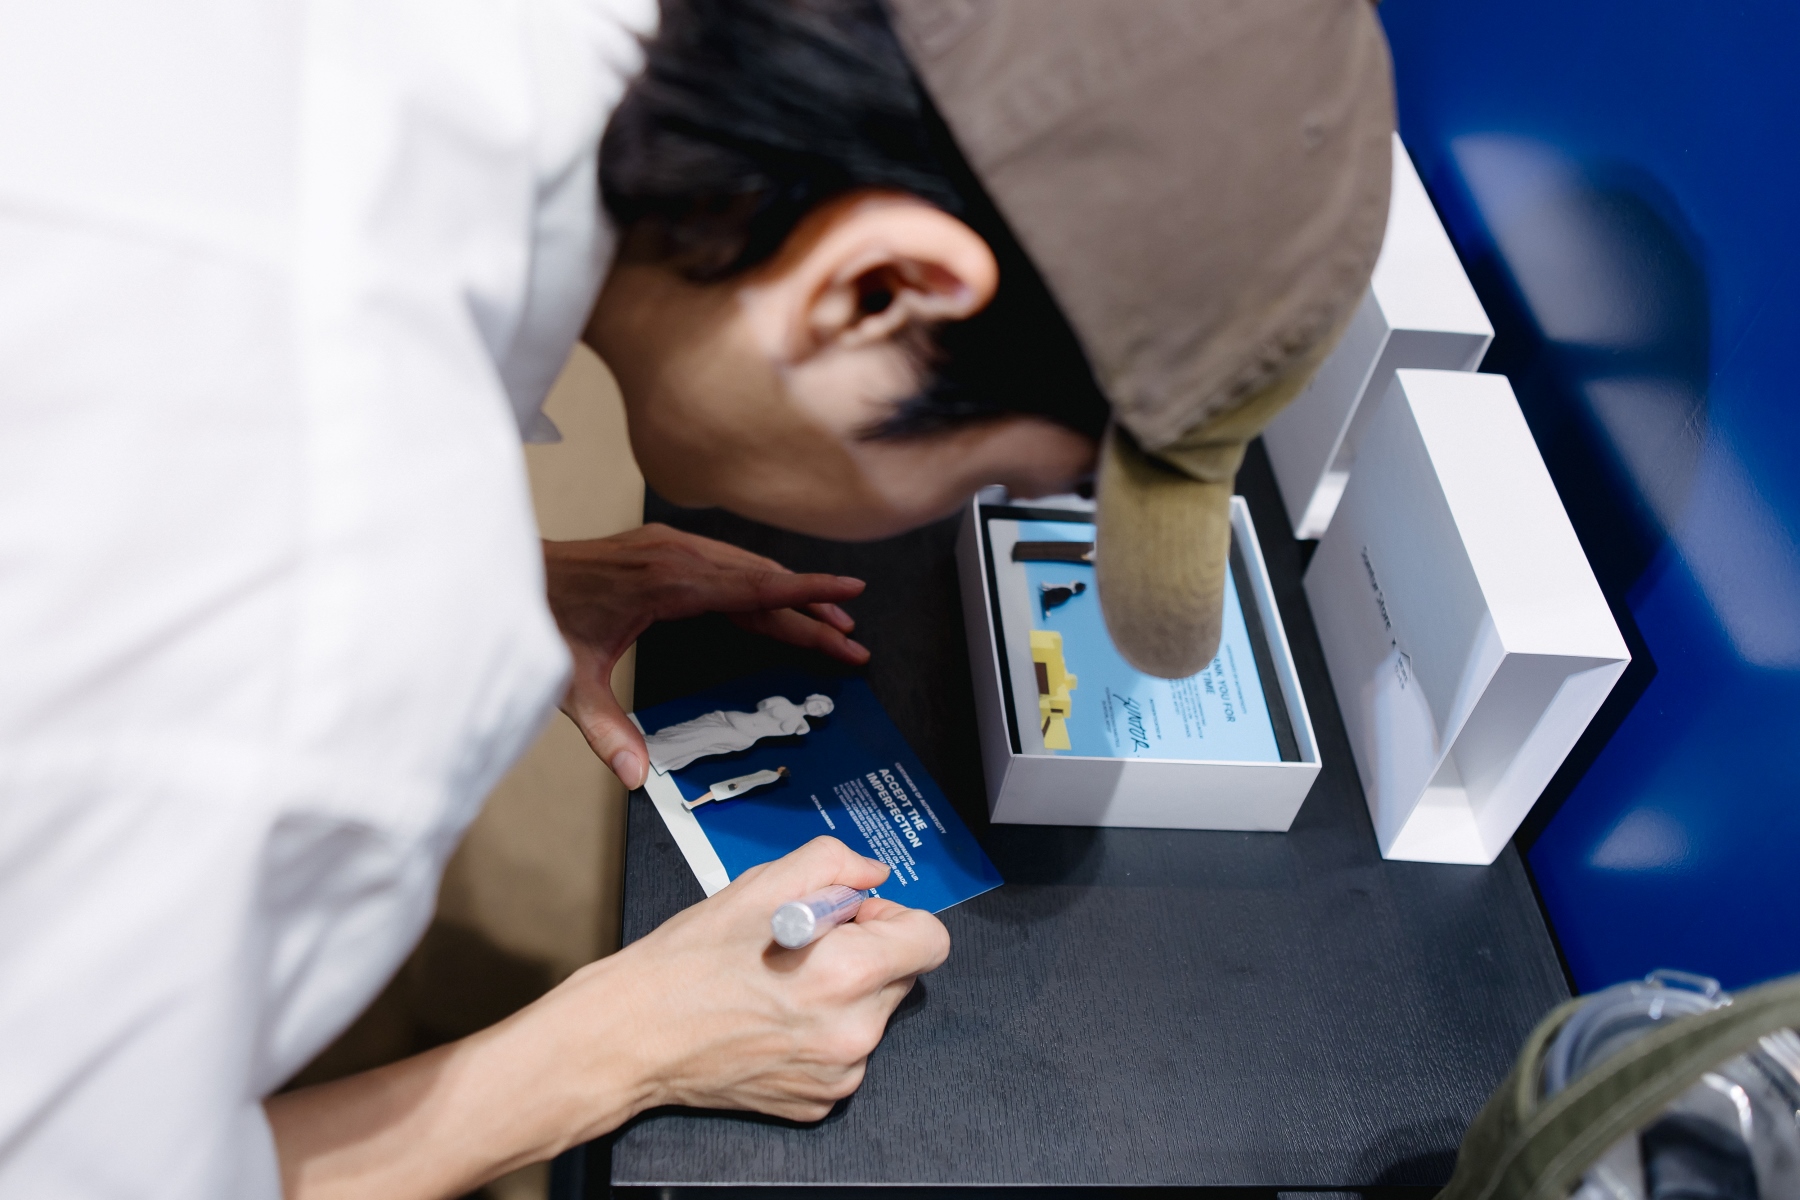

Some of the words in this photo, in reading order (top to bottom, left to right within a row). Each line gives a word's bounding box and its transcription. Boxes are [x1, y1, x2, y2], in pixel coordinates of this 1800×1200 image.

[1376, 592, 1392, 630] Store
[1200, 672, 1215, 695] TIME
[1214, 658, 1225, 677] ANK
[1217, 678, 1230, 706] YOU
[1223, 703, 1236, 723] FOR
[809, 794, 823, 809] SERIAL
[819, 809, 836, 829] NUMBER
[832, 786, 840, 794] ALL
[837, 794, 851, 810] RIGHTS
[847, 810, 865, 832] RESERVED
[866, 839, 876, 848] THE
[854, 778, 864, 788] THIS
[861, 788, 878, 809] CERTIFIES
[874, 809, 886, 821] THAT
[882, 820, 892, 830] THE
[888, 829, 915, 865] ACCOMPANYING
[865, 771, 923, 848] IMPERFECTION
[878, 766, 912, 808] ACCEPT
[906, 808, 928, 831] THE
[894, 761, 918, 791] CERTIFICATE
[914, 791, 923, 799] OF
[919, 798, 946, 834] AUTHENTICITY
[848, 779, 866, 801] ARTWORK
[865, 805, 874, 813] AN
[870, 813, 890, 837] AUTHENTIC
[886, 837, 902, 855] EDITION
[902, 862, 919, 881] SUNTUR
[853, 797, 868, 815] PRINTED
[865, 815, 878, 829] USING
[874, 829, 884, 839] FINE
[880, 839, 890, 848] ART
[887, 848, 895, 856] UV
[892, 855, 900, 863] ON
[871, 835, 897, 869] SEMI-OUTDOOR
